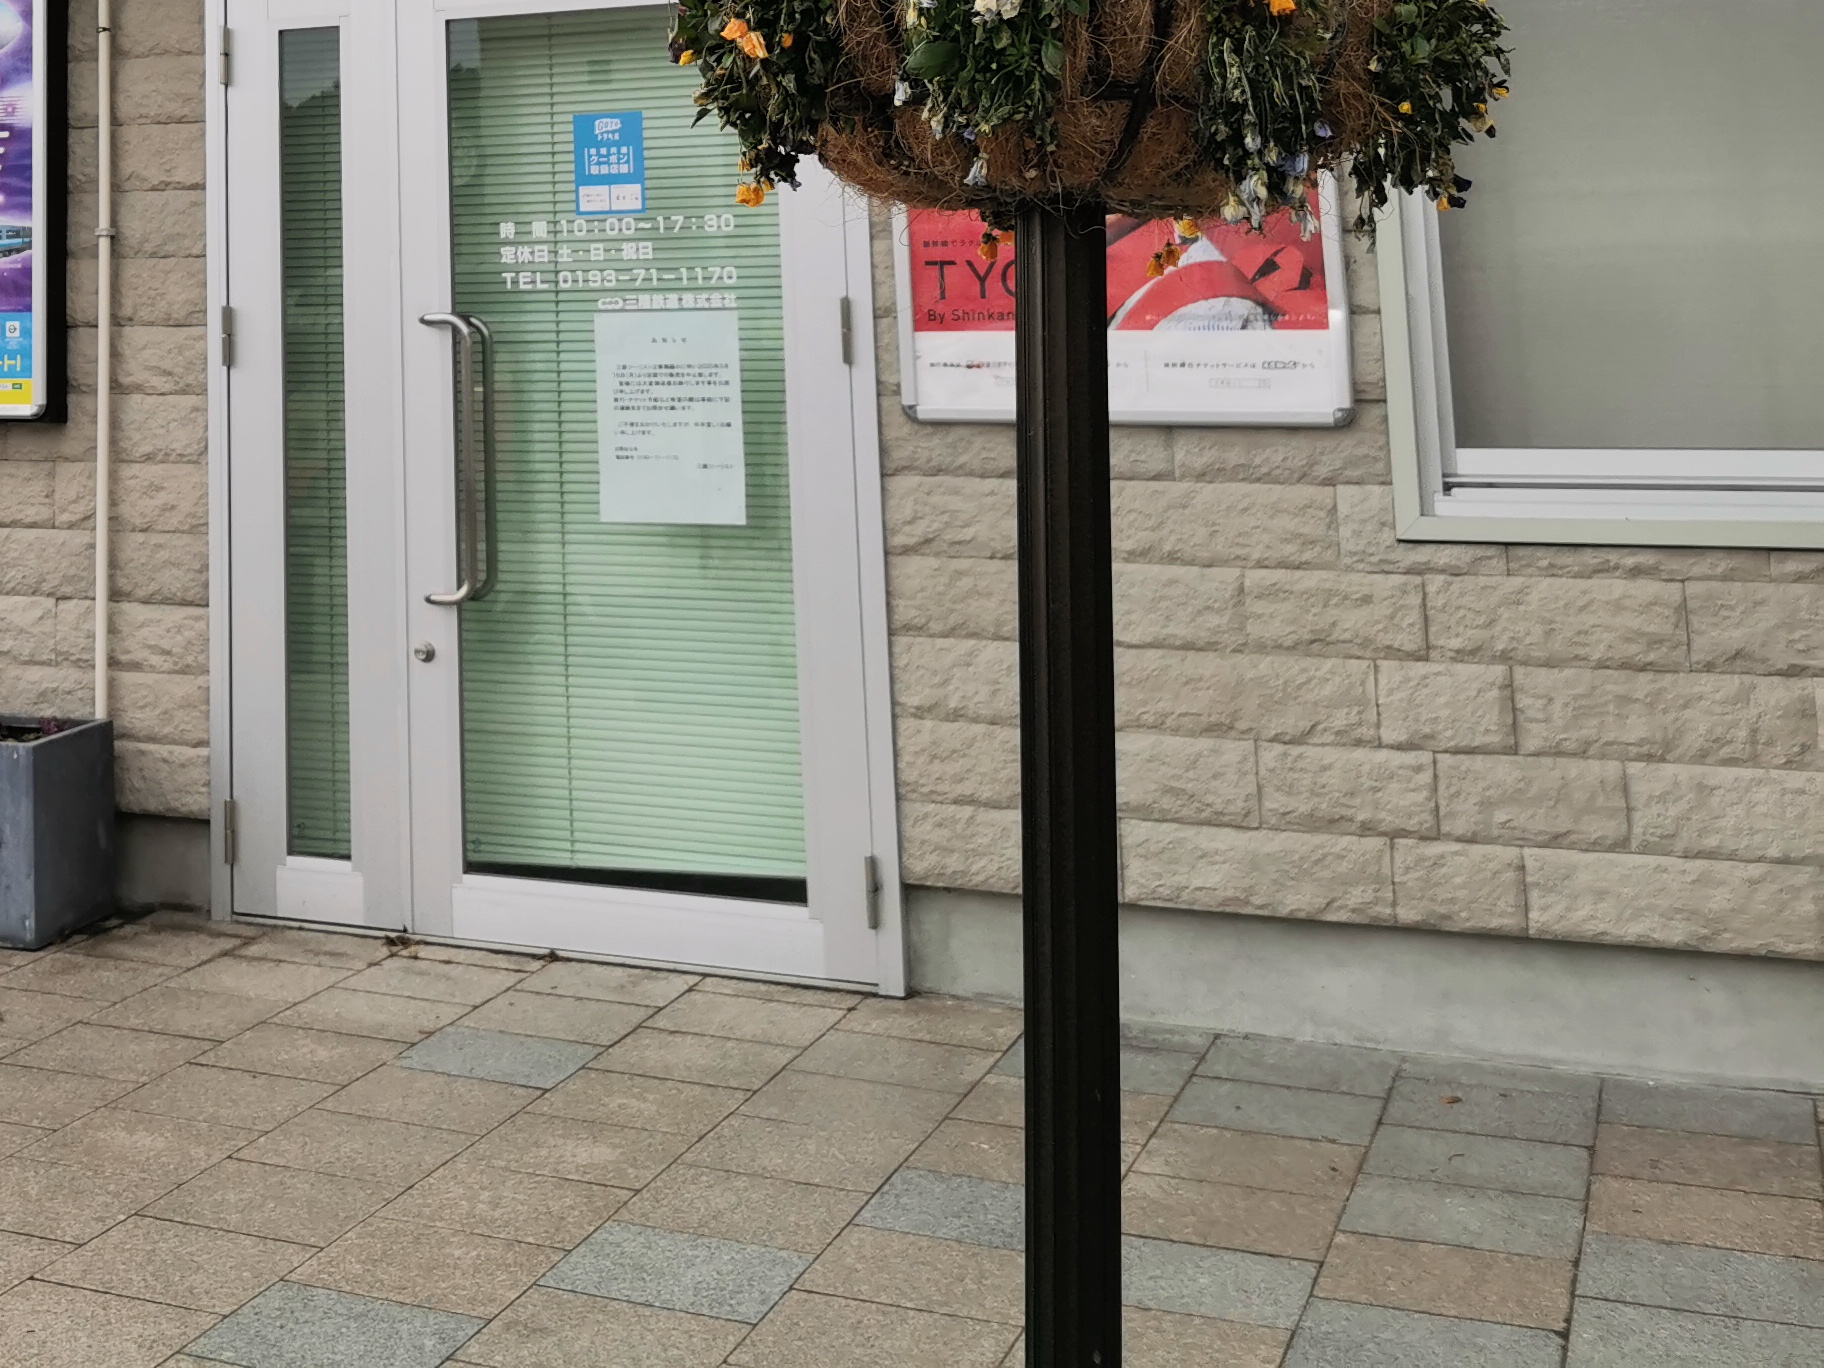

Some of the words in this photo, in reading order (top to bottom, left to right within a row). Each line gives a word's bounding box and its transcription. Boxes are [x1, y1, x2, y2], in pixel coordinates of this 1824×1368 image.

[589, 153, 629, 165] クーポン
[499, 245, 549, 264] 定休日
[501, 271, 550, 289] TEL
[558, 267, 738, 288] 0193-71-1170
[927, 309, 945, 324] By
[951, 309, 1015, 322] Shinkan
